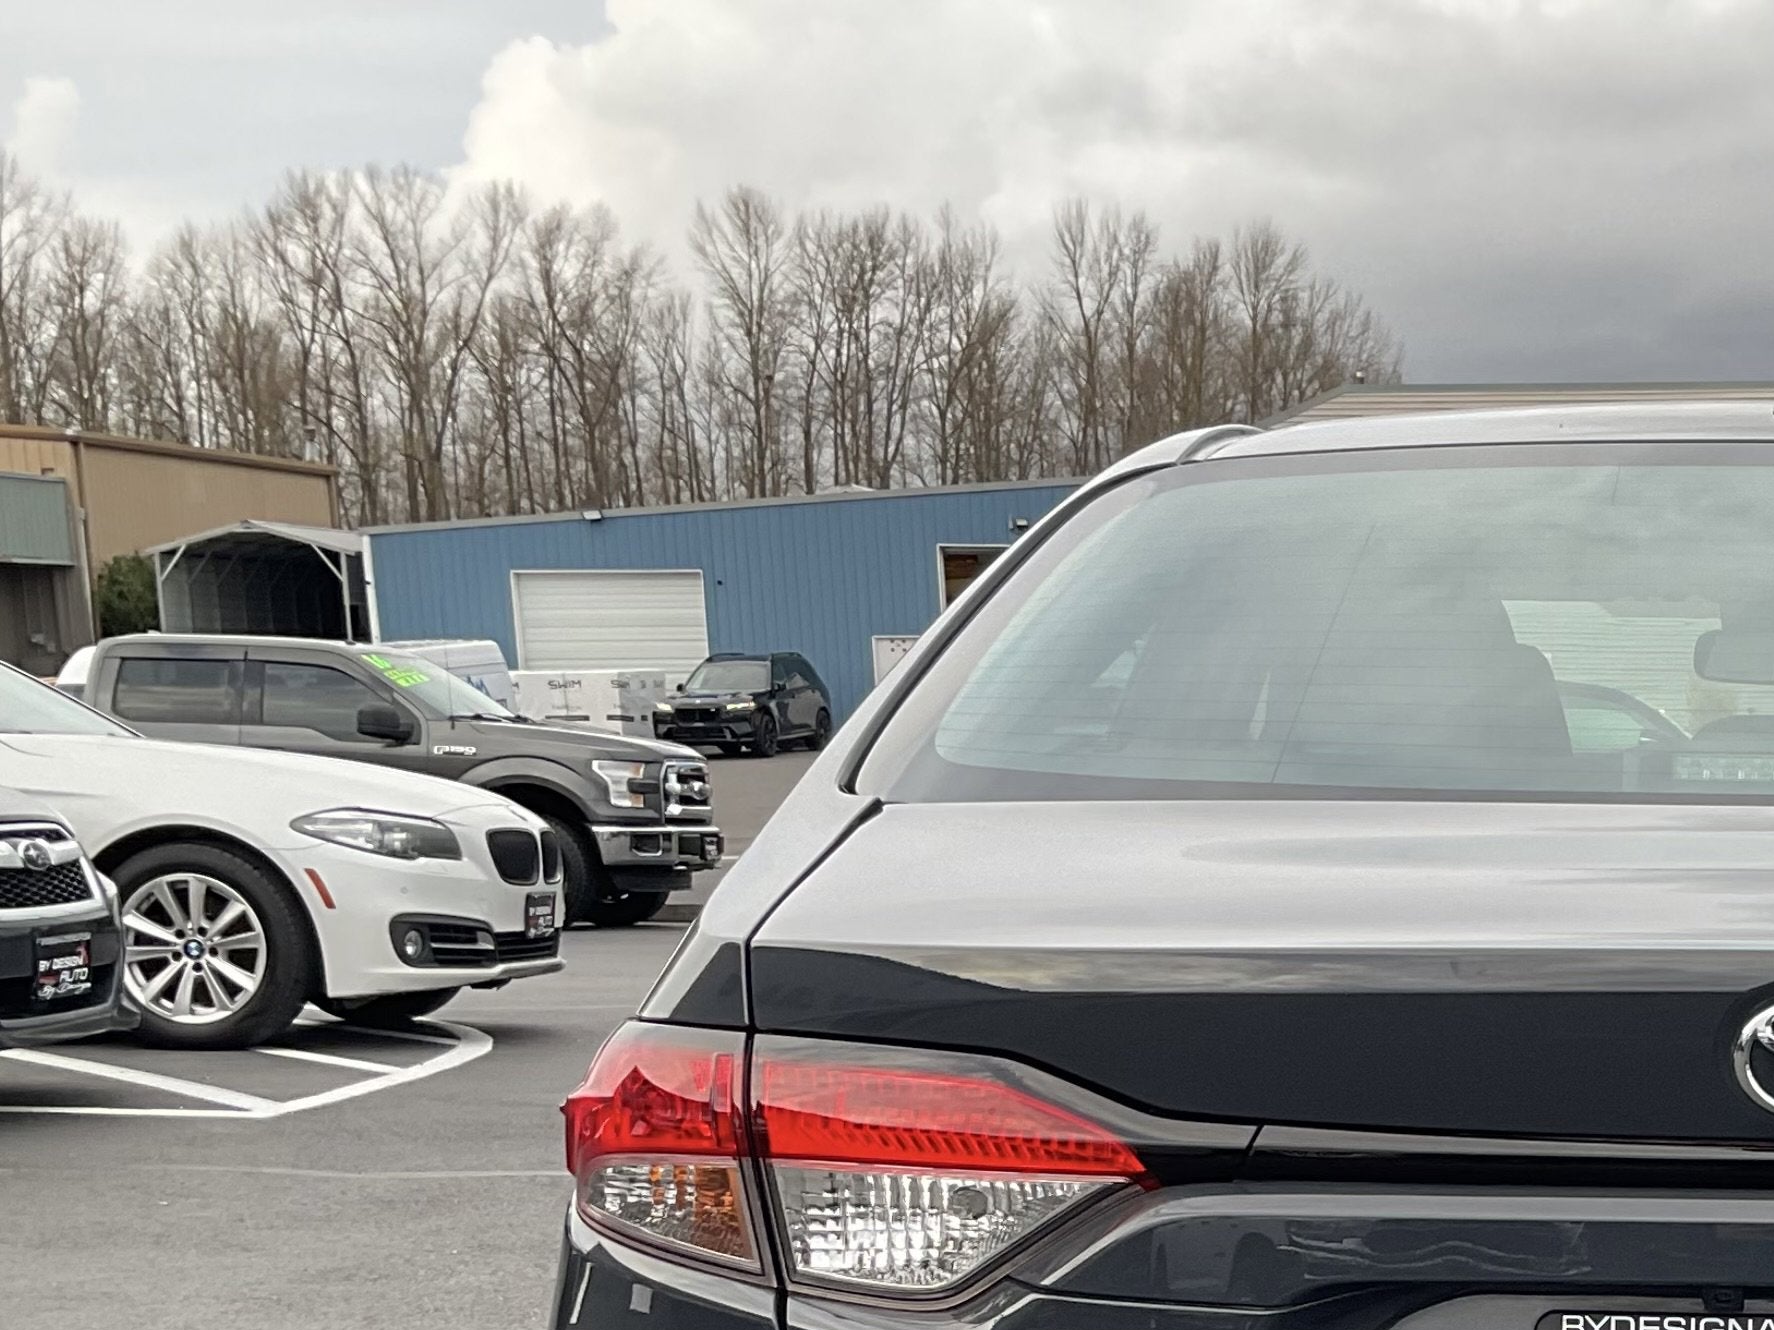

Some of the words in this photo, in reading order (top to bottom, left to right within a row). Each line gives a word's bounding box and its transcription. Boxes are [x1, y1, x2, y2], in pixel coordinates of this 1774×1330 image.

[547, 679, 582, 690] SWIM
[52, 956, 83, 970] DESIGN
[59, 967, 89, 983] AUTO
